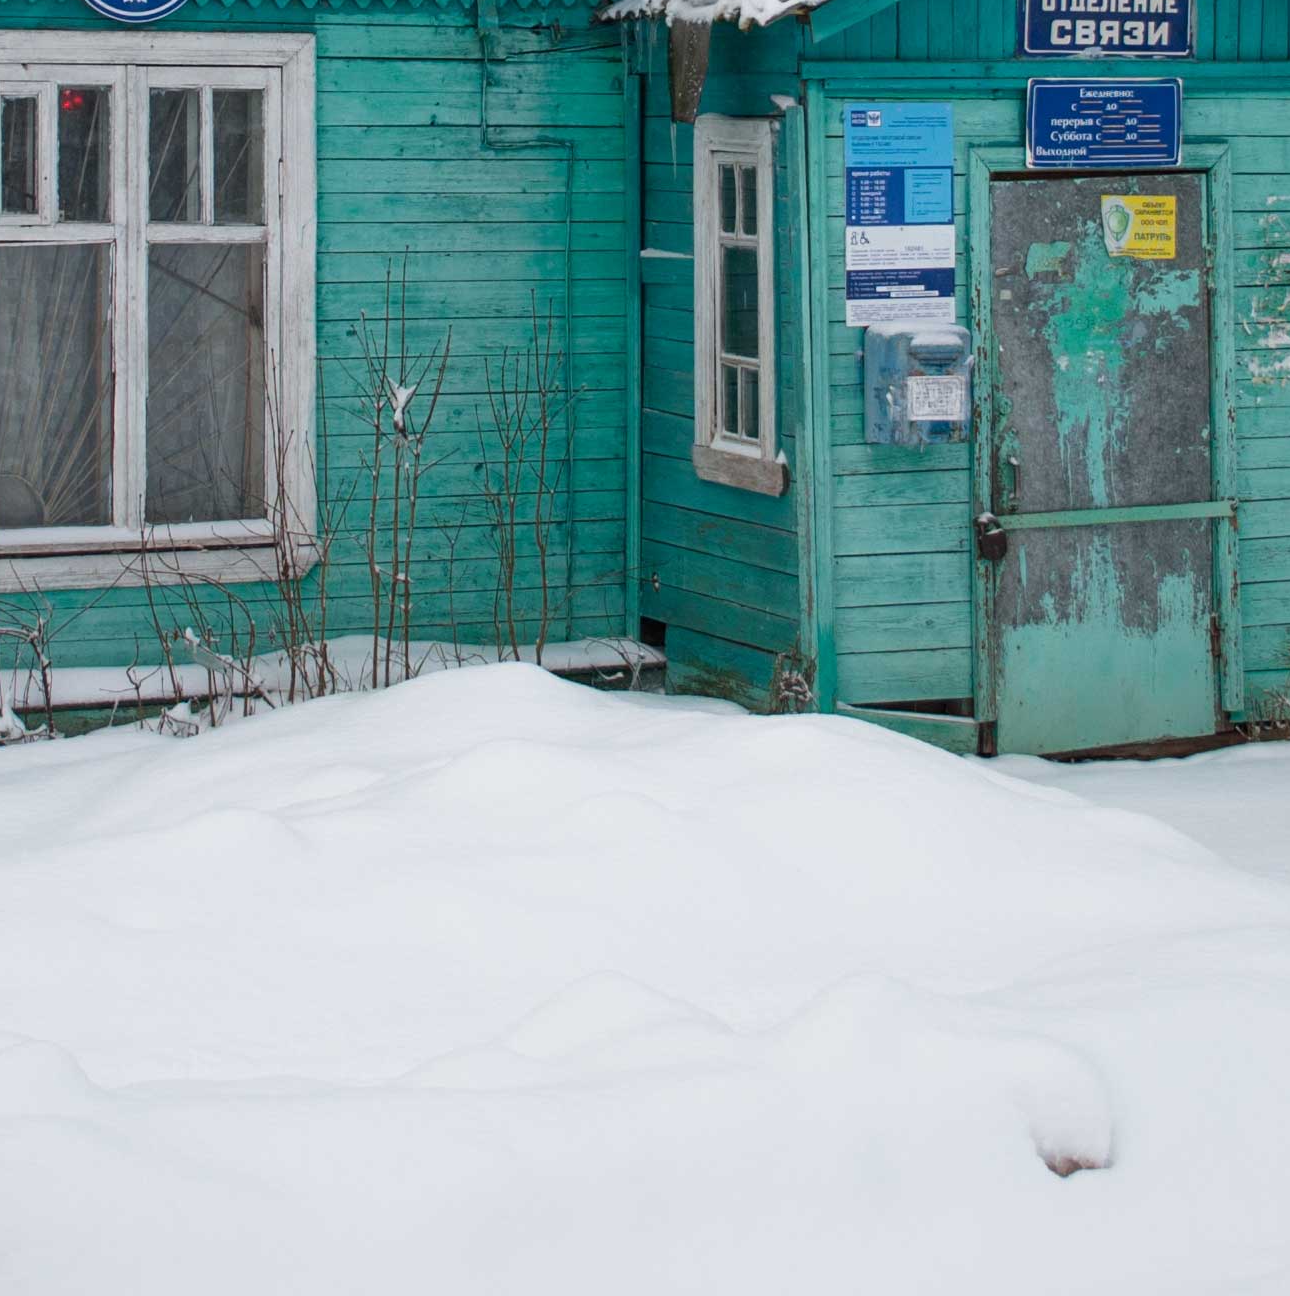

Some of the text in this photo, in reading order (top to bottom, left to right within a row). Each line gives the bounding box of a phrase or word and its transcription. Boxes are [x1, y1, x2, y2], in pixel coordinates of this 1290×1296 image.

[1050, 19, 1169, 46] СВЯЗИ
[1079, 88, 1134, 99] Ежедневно:
[1071, 103, 1118, 111] с до
[1050, 117, 1137, 129] перерыв с до
[1050, 131, 1137, 143] Суббота с до
[1035, 146, 1087, 157] Выходной
[870, 170, 891, 178] работы
[1134, 232, 1171, 241] ПАТРУЛЬ
